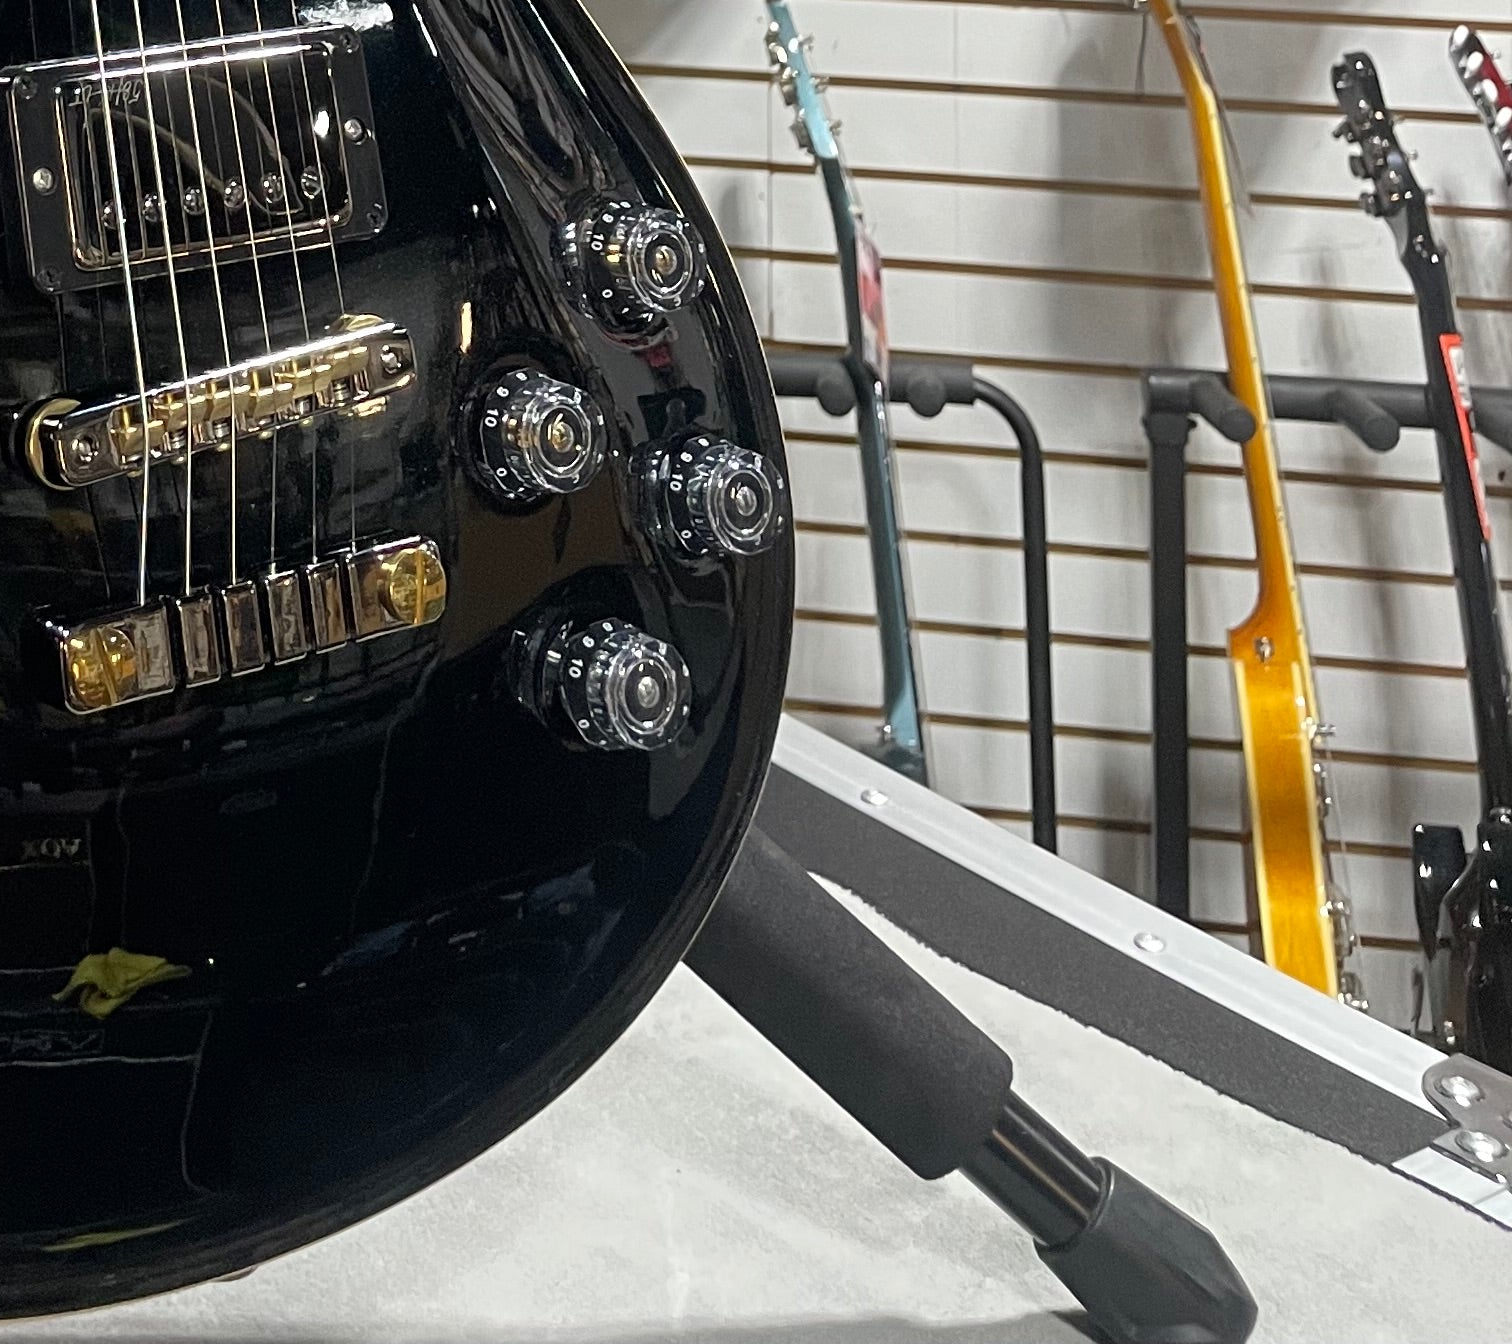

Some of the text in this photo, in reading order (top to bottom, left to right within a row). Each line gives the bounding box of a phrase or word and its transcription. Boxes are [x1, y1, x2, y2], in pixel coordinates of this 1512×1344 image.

[591, 233, 604, 251] 10
[484, 408, 499, 428] 10
[670, 473, 684, 492] 10
[568, 658, 584, 679] 10
